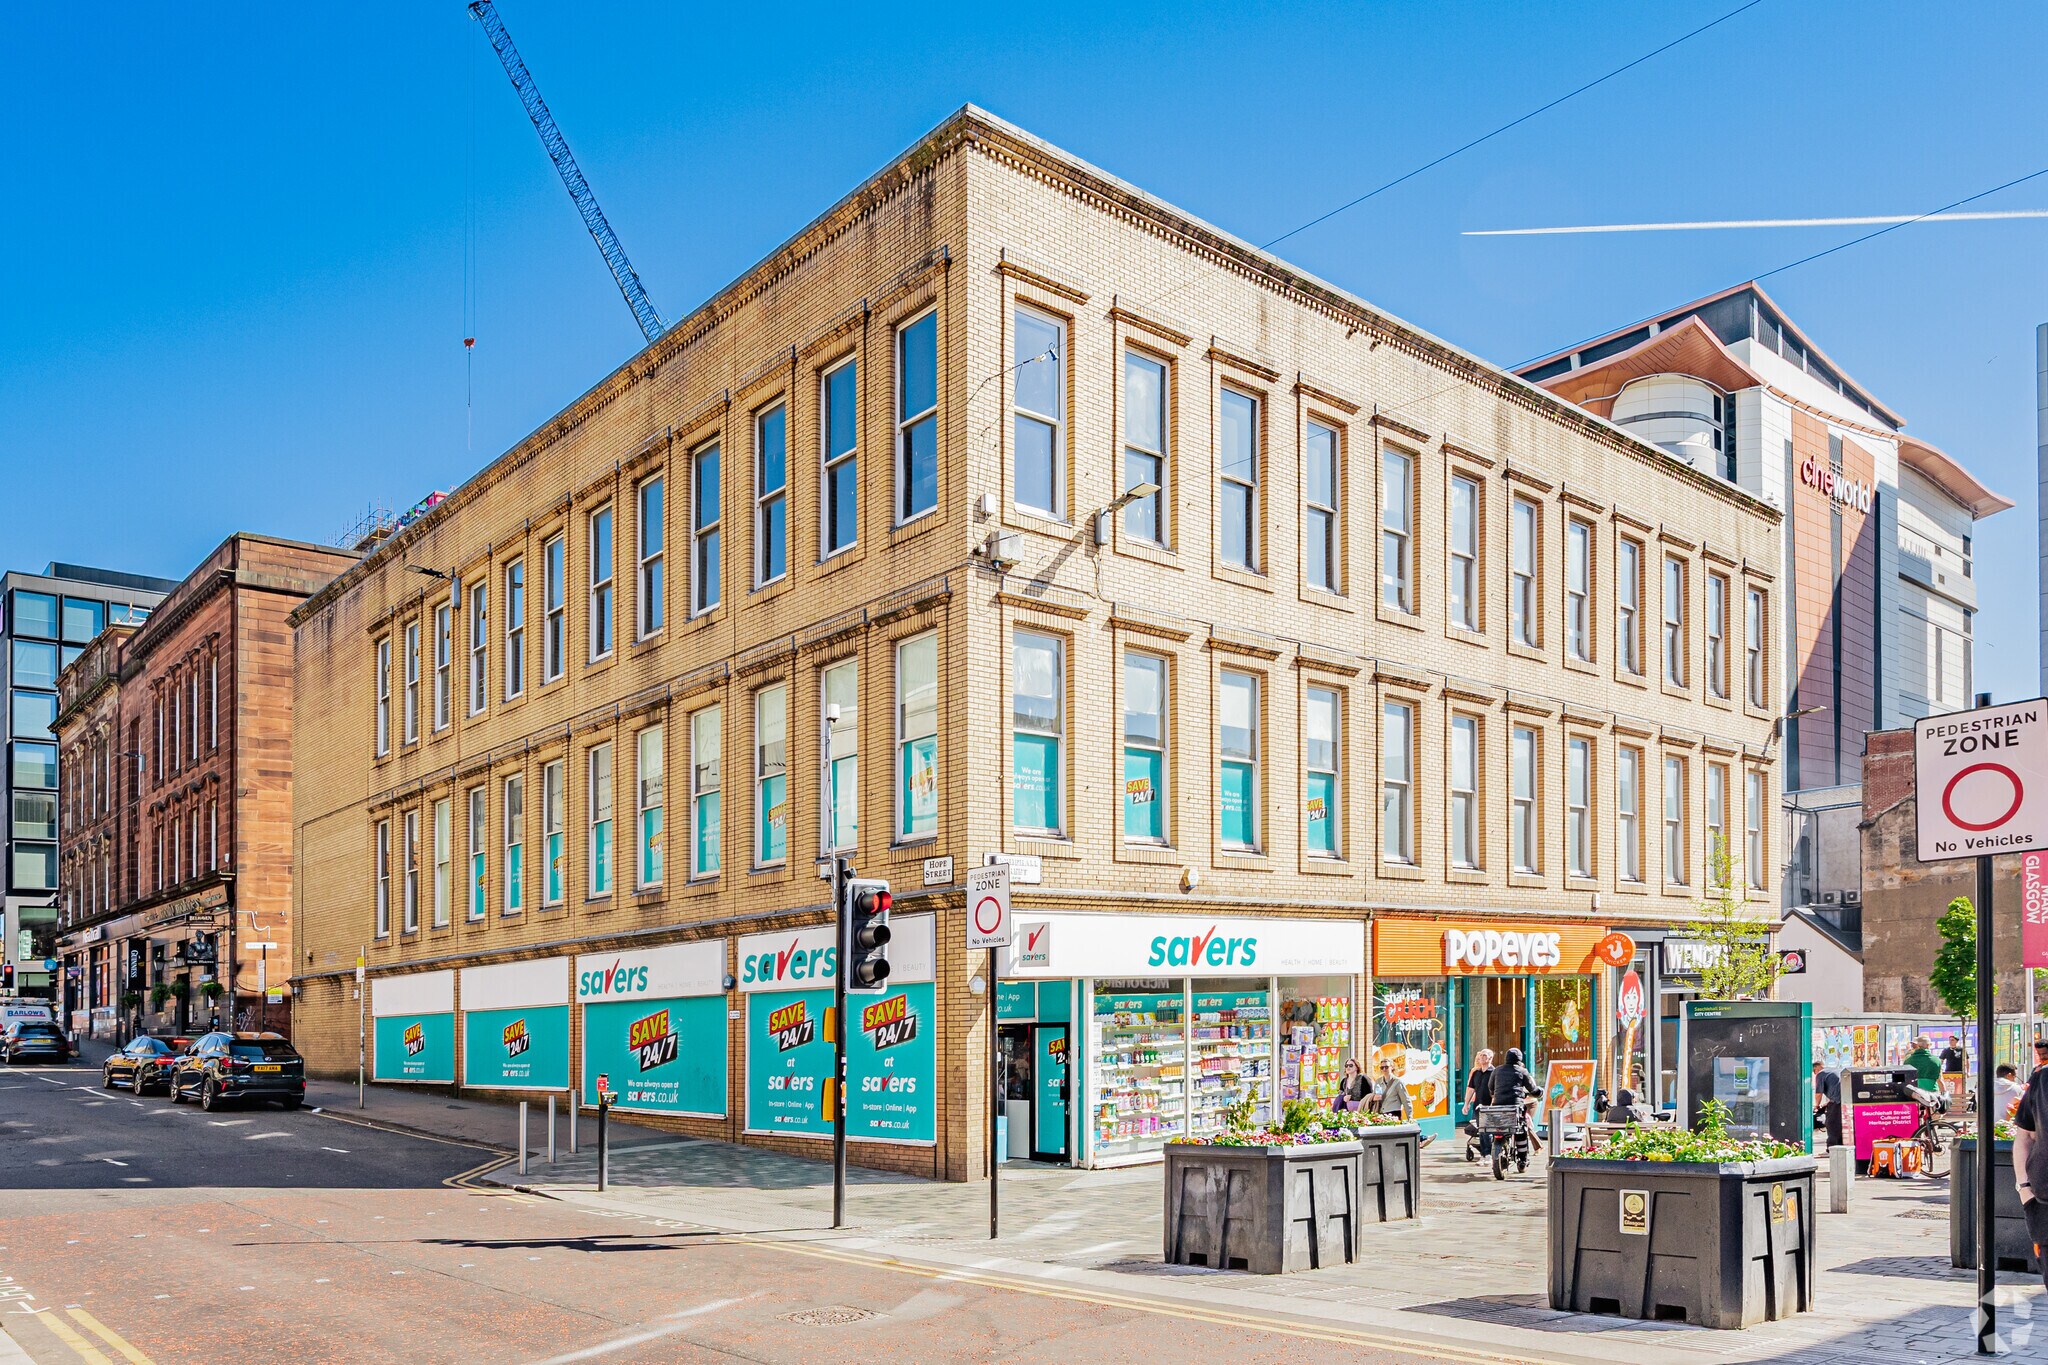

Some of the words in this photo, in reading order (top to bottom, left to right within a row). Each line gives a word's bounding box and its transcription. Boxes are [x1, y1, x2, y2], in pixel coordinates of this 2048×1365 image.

[1801, 455, 1870, 514] cineworld
[1926, 711, 2038, 739] PEDESTRIAN
[1943, 729, 2019, 756] ZONE
[1128, 779, 1148, 792] SAVE
[1134, 790, 1153, 803] 24/7
[1310, 808, 1326, 820] 24/7
[1936, 841, 1957, 852] No
[1965, 834, 2033, 849] Vehicles
[929, 860, 947, 868] HOPE
[925, 869, 951, 878] STREET
[970, 870, 1006, 880] PEDESTRIAN
[976, 879, 1000, 891] ZONE
[2026, 856, 2040, 924] GLASGOW
[1147, 925, 1257, 966] savers
[743, 938, 836, 983] savers
[1022, 952, 1046, 962] savers
[903, 963, 926, 971] BEAUTY
[580, 958, 648, 996] savers
[1114, 998, 1142, 1009] savers
[1157, 998, 1183, 1008] savers
[1198, 997, 1223, 1007] savers
[1236, 996, 1260, 1006] savers
[1384, 988, 1421, 1004] shatter
[772, 1003, 804, 1031] SAVE
[866, 997, 904, 1027] SAVE
[504, 1021, 524, 1042] SAVE
[632, 1012, 667, 1046] SAVE
[1400, 1018, 1432, 1031] savers
[404, 1023, 420, 1042] SAVE
[781, 1020, 812, 1050] 24/7
[878, 1017, 915, 1048] 24/7
[409, 1036, 424, 1054] 24/7
[510, 1035, 528, 1056] 24/7
[642, 1035, 676, 1069] 24/7
[787, 1058, 795, 1067] at
[884, 1057, 894, 1067] at
[644, 1080, 660, 1089] always
[768, 1072, 814, 1091] savers
[862, 1072, 916, 1093] savers
[628, 1089, 678, 1103] savers.co.uk
[906, 1105, 916, 1113] App
[774, 1114, 808, 1123] savers.co.uk
[870, 1119, 909, 1129] savers.co.uk
